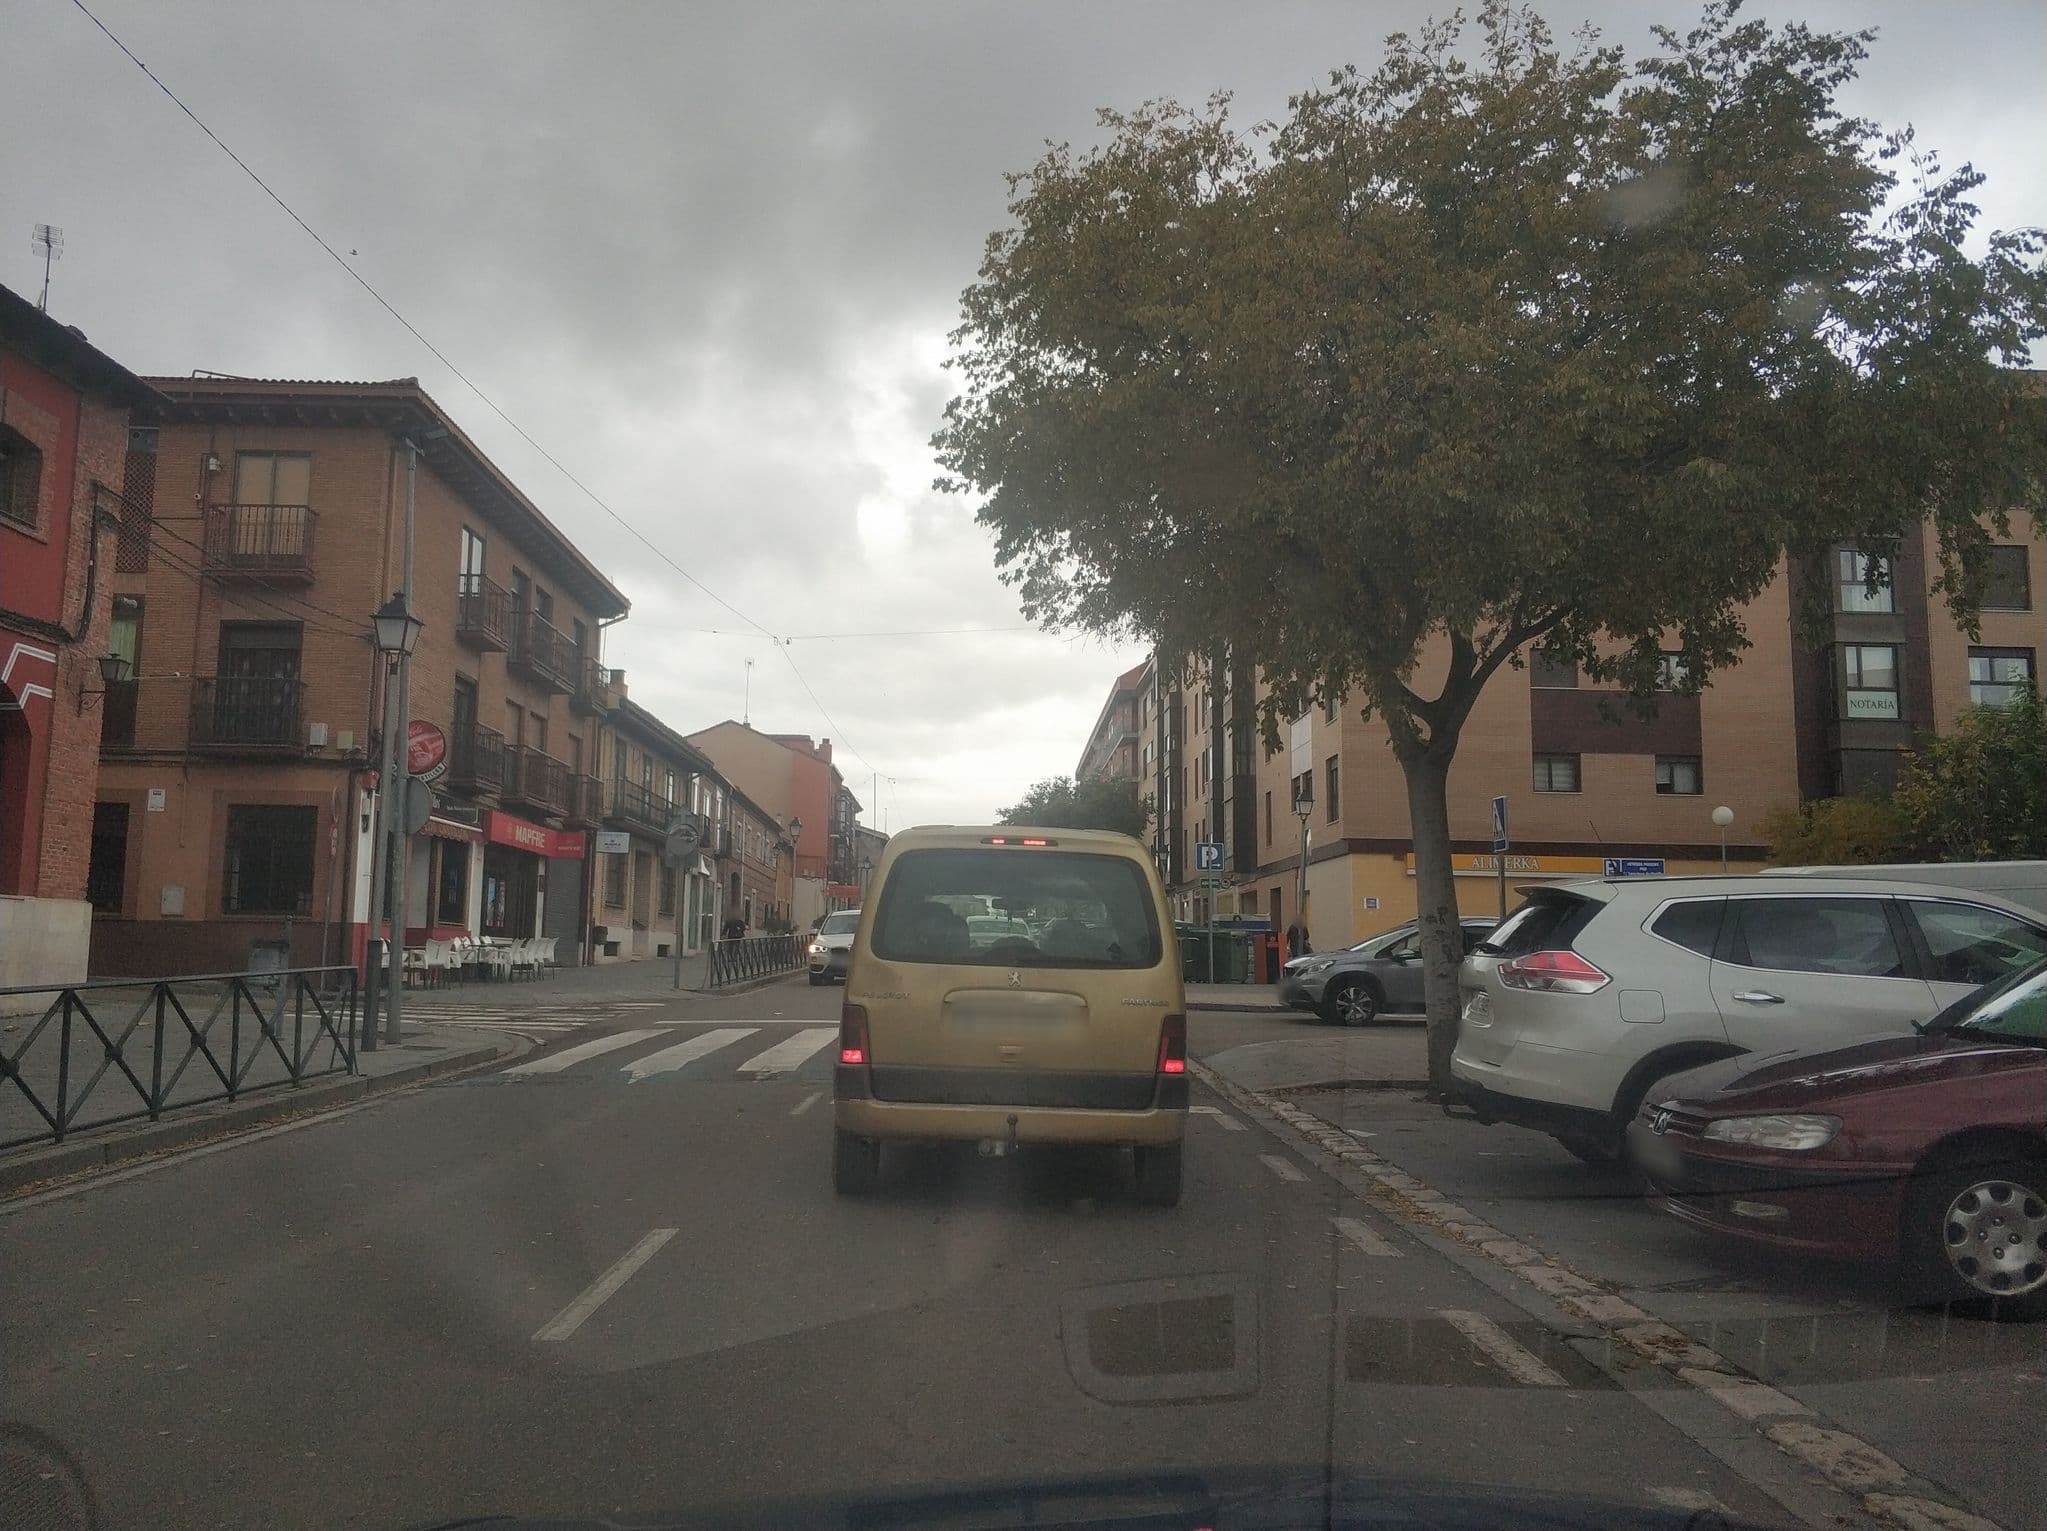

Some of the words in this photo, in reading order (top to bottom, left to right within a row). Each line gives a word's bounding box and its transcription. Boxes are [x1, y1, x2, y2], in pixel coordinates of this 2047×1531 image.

[1850, 698, 1894, 709] NOTARÍA
[515, 825, 546, 849] MAPFRE
[1201, 846, 1218, 868] P
